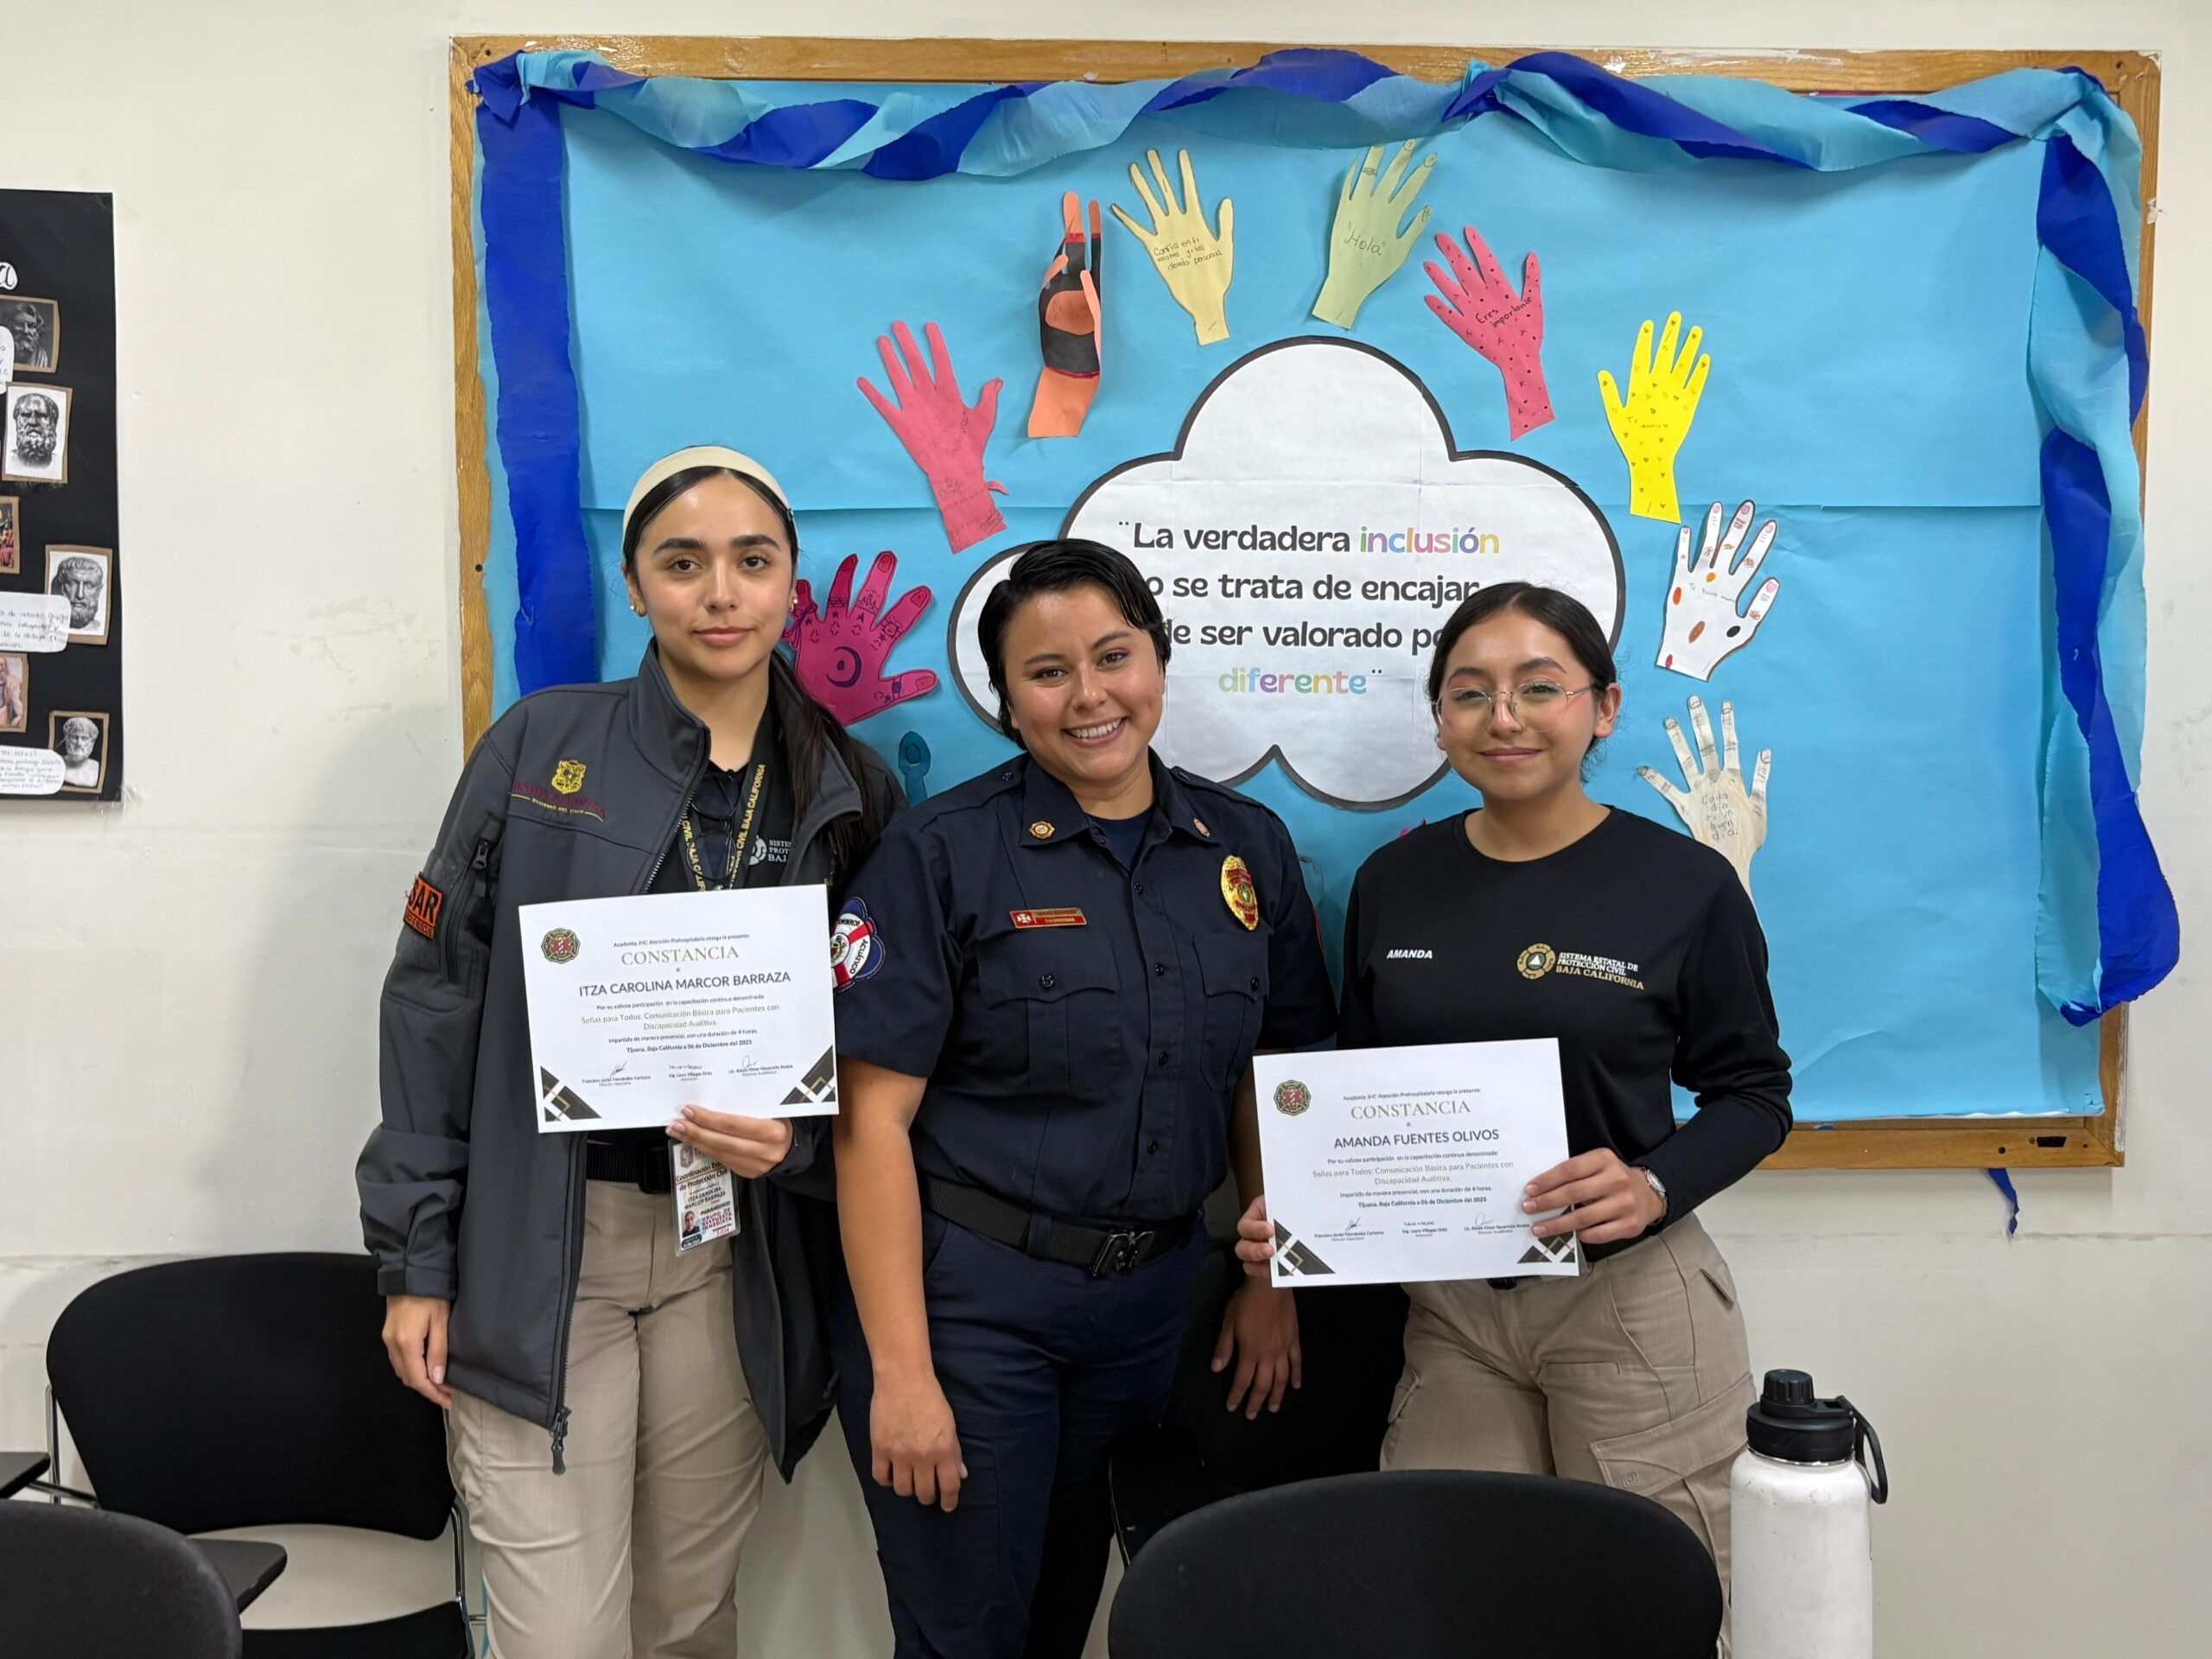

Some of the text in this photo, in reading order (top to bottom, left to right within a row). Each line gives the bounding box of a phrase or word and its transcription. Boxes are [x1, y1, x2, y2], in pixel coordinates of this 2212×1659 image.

[1475, 309, 1499, 324] Eres
[1492, 296, 1533, 328] importante
[1183, 524, 1351, 554] verdadera
[1359, 525, 1501, 555] inclusión
[1145, 574, 1480, 609] o se trata de encajar
[1199, 623, 1253, 646] ser
[1262, 620, 1403, 649] valorado
[736, 764, 766, 849] CIVIL BAJA CALIFORNIA
[409, 878, 439, 924] SAR
[621, 945, 739, 966] CONSTANCIA
[1386, 949, 1433, 959] AMANDA
[1559, 952, 1639, 972] SISTEMA ESTATAL DE
[1555, 965, 1644, 990] BAJA CALIFORNIA
[1606, 966, 1626, 976] CIVIL
[579, 971, 791, 997] ITZA CAROLINA MARCOR BARRAZA
[644, 1020, 687, 1030] Discapacidad
[1351, 1100, 1471, 1120] CONSTANCIA
[1334, 1128, 1499, 1148] AMANDA FUENTES OLIVOS
[677, 1165, 711, 1182] Coordinación
[687, 1174, 715, 1188] Protección
[1375, 1177, 1420, 1185] Discapacidad
